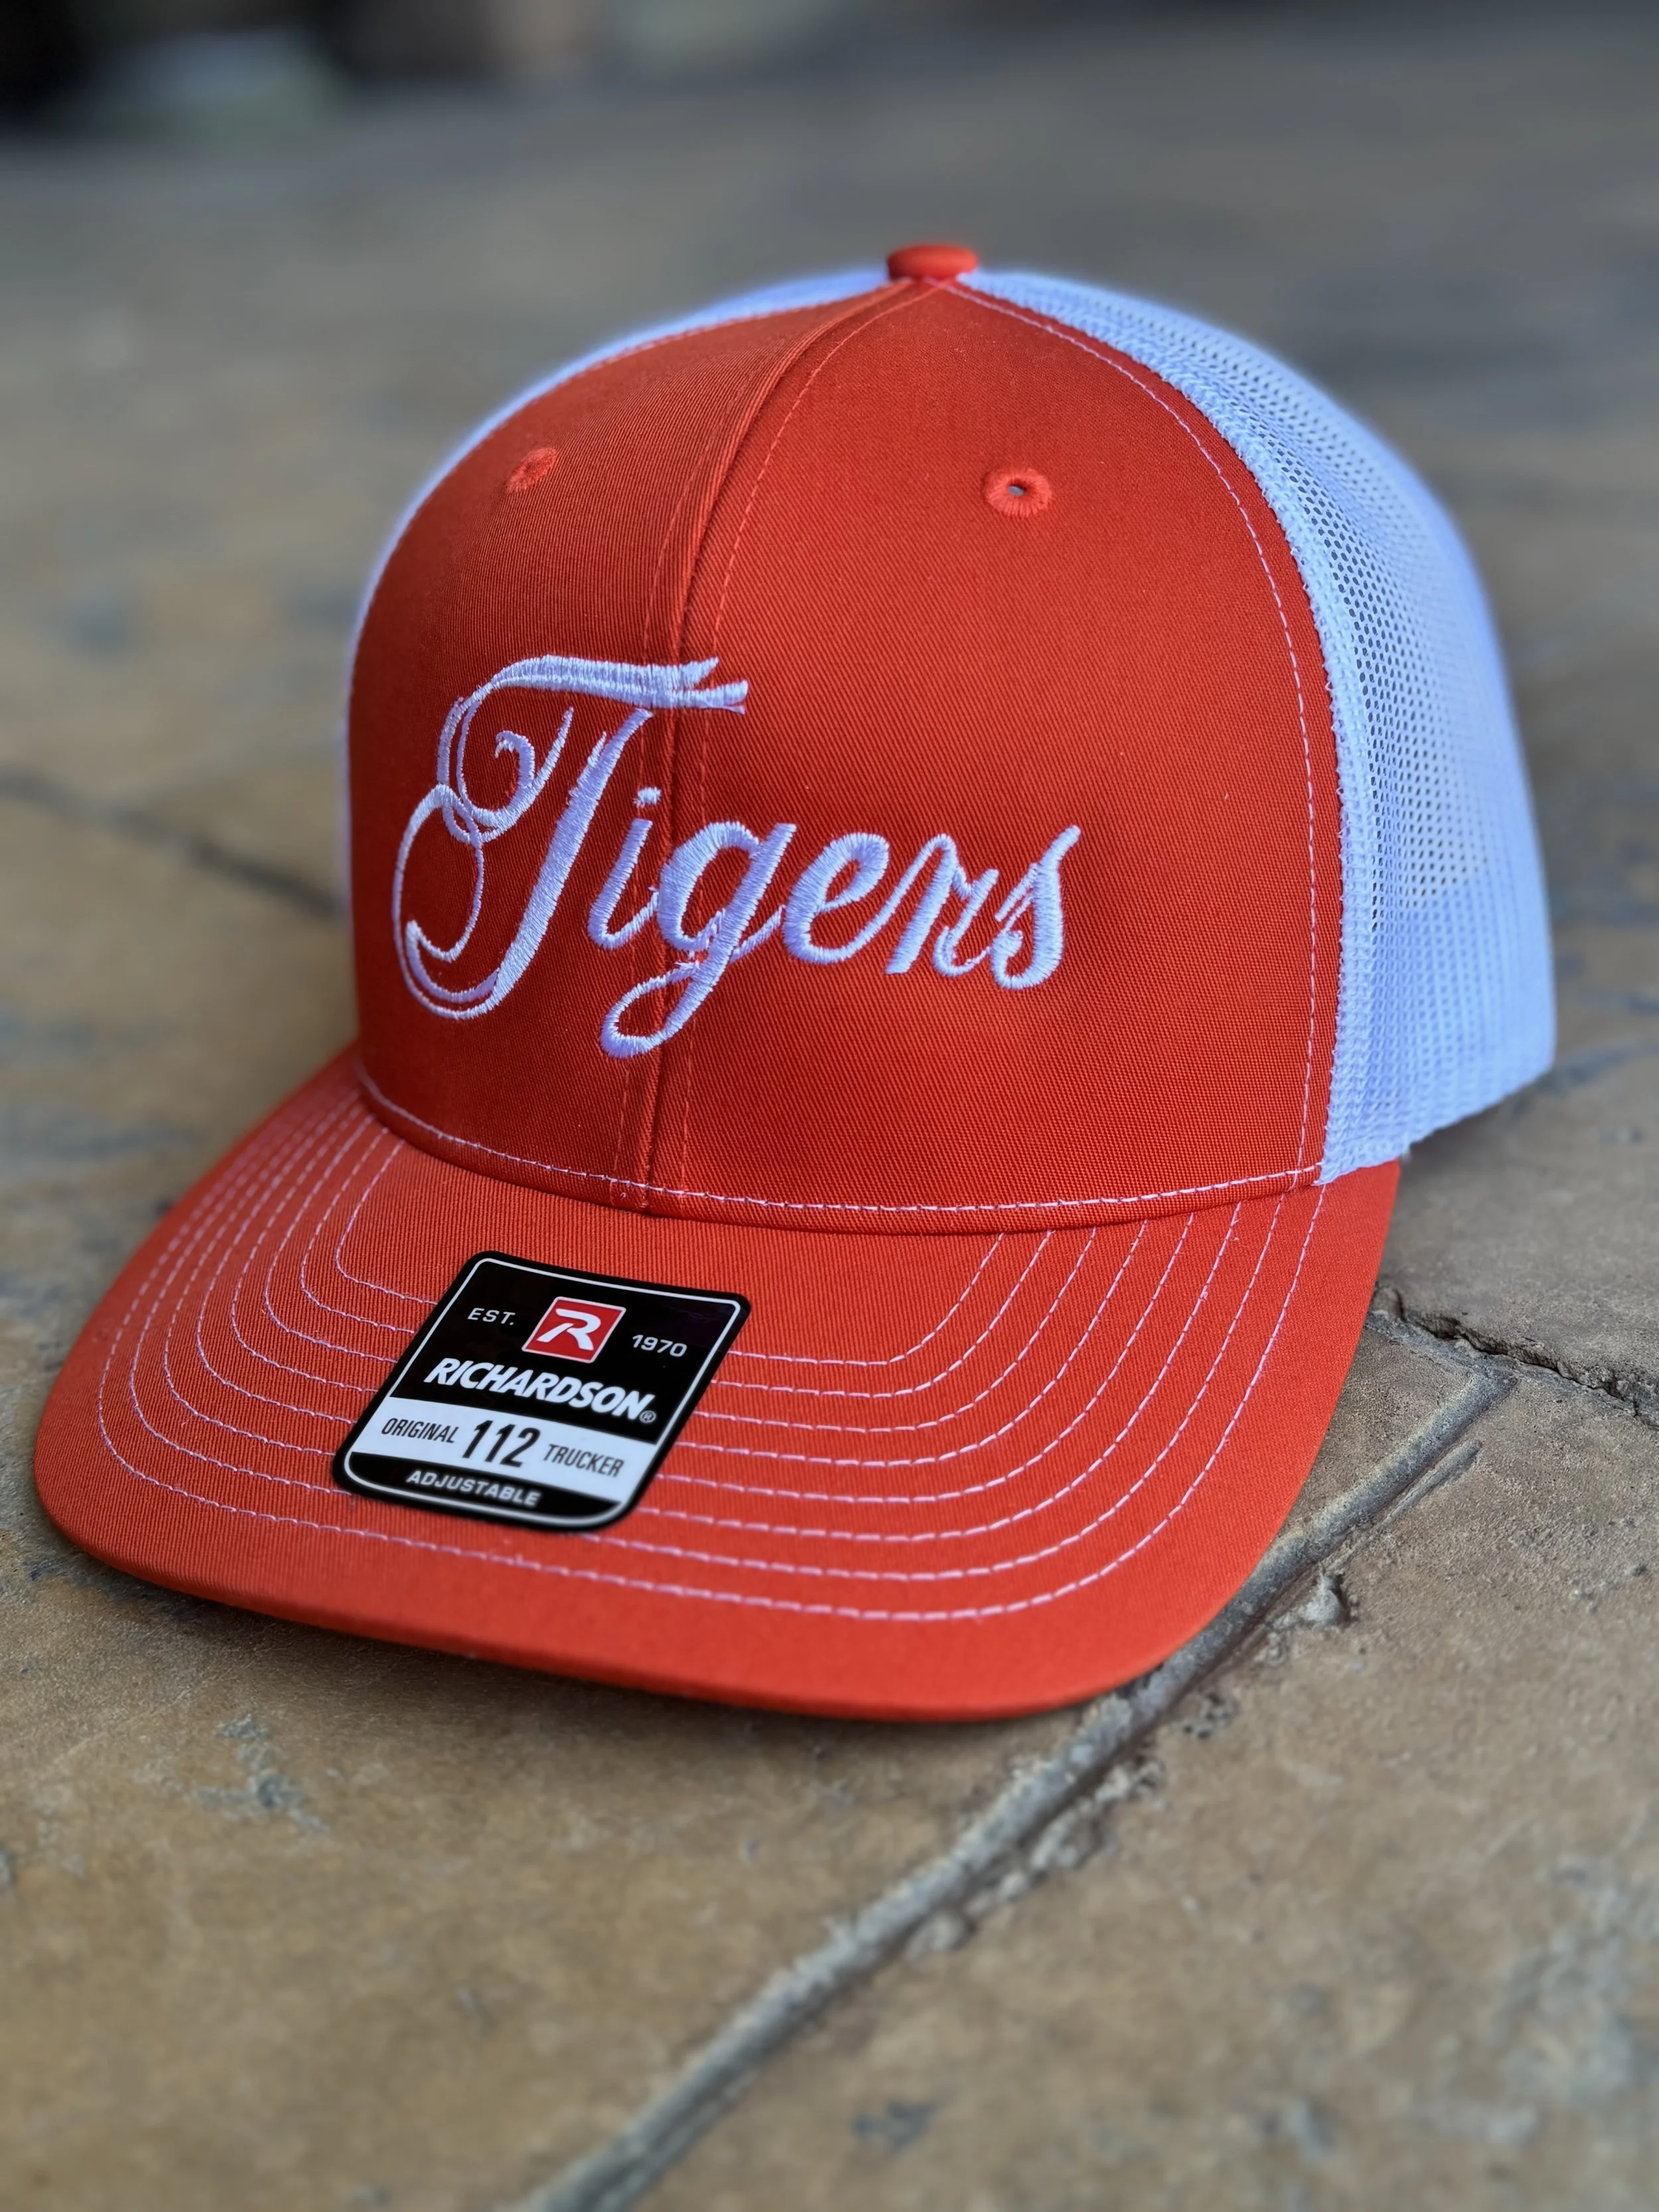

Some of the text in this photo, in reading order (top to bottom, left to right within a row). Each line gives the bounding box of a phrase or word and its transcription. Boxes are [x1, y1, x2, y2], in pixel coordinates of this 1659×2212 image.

[393, 654, 1080, 1060] Tigers
[467, 1307, 687, 1358] EST. 1970
[536, 1307, 603, 1352] R
[381, 1417, 624, 1479] ORIGINAL 112 TRUCKER
[405, 1469, 543, 1507] ADJUSTABLE
